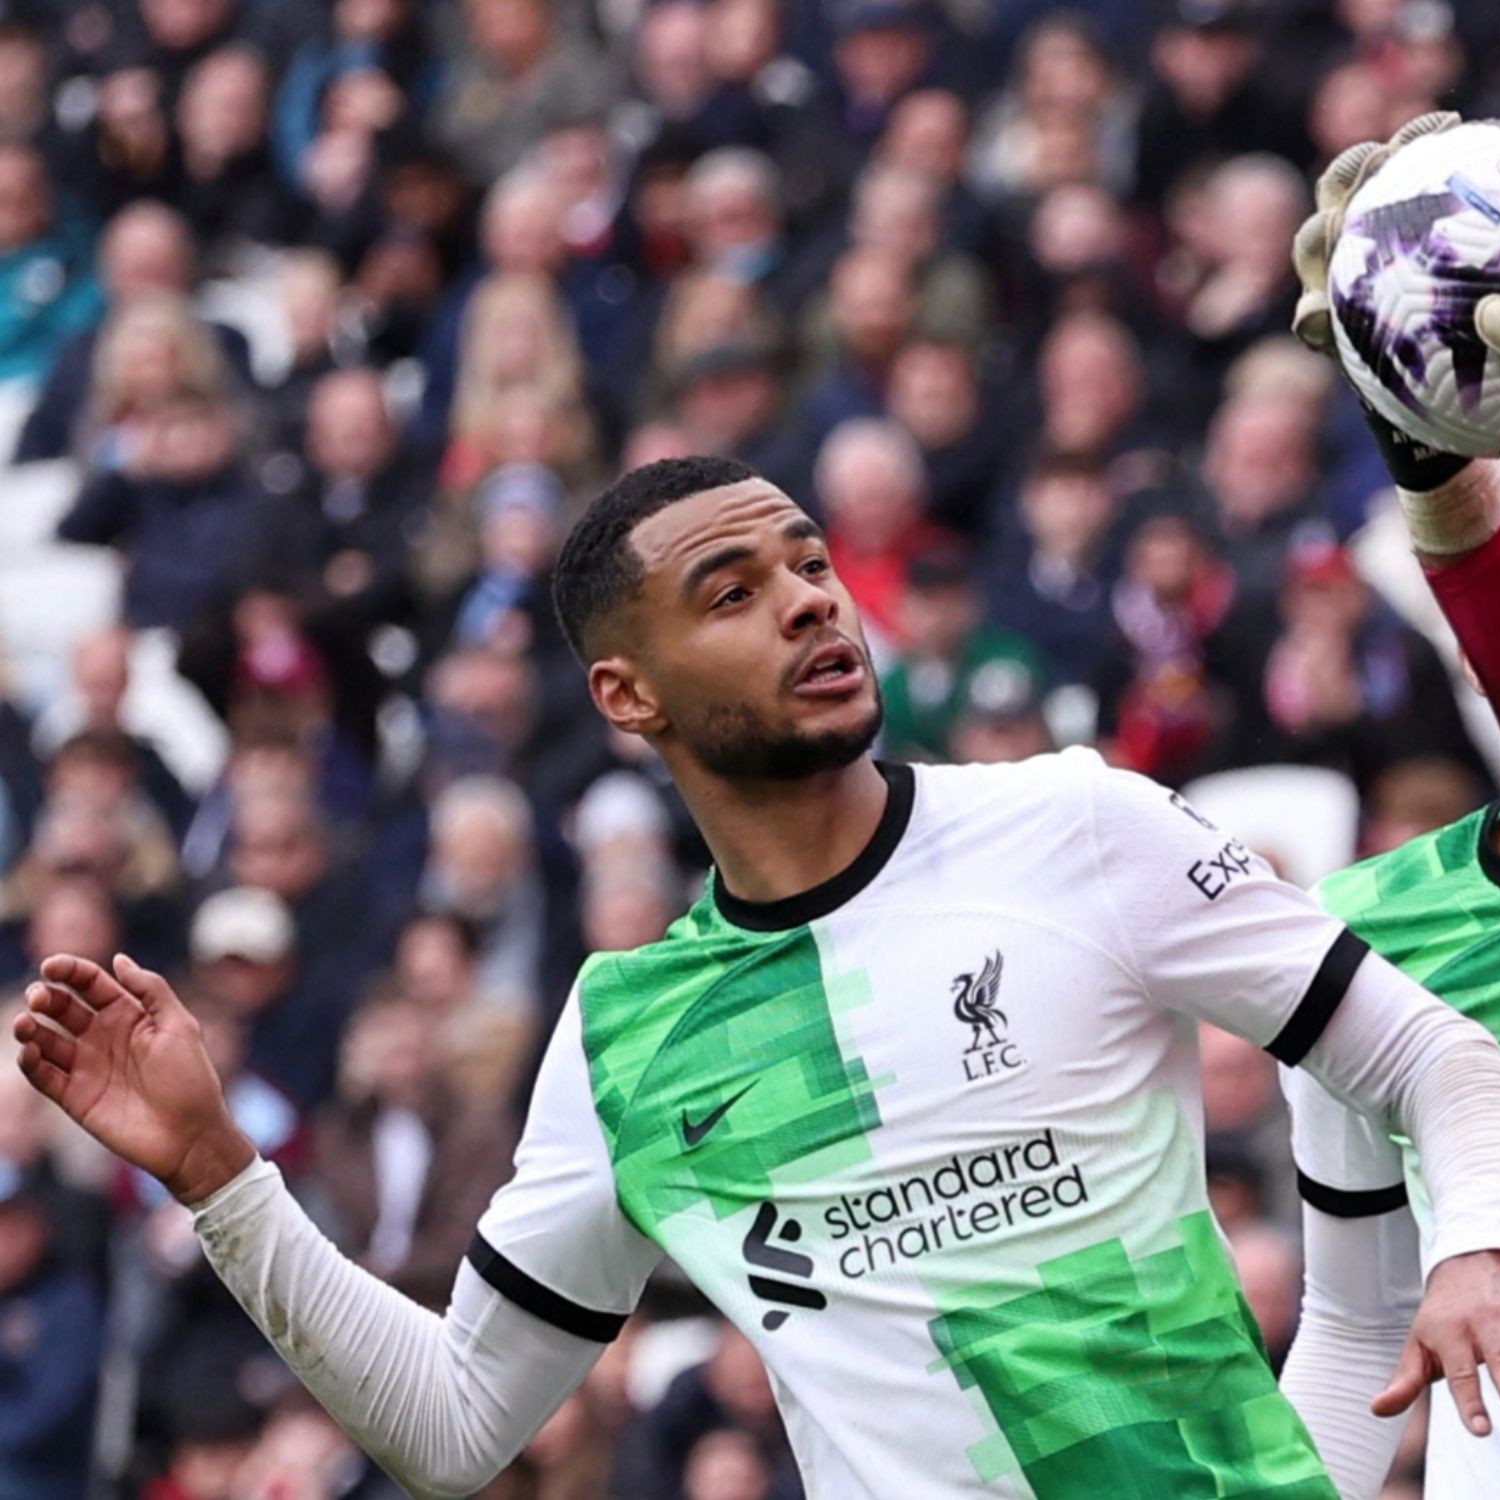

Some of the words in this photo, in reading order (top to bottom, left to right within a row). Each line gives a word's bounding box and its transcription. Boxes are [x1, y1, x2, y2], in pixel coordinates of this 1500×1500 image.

[962, 1044, 1028, 1082] L.F.C.
[824, 1127, 1060, 1239] standard
[839, 1164, 1089, 1279] chartered
